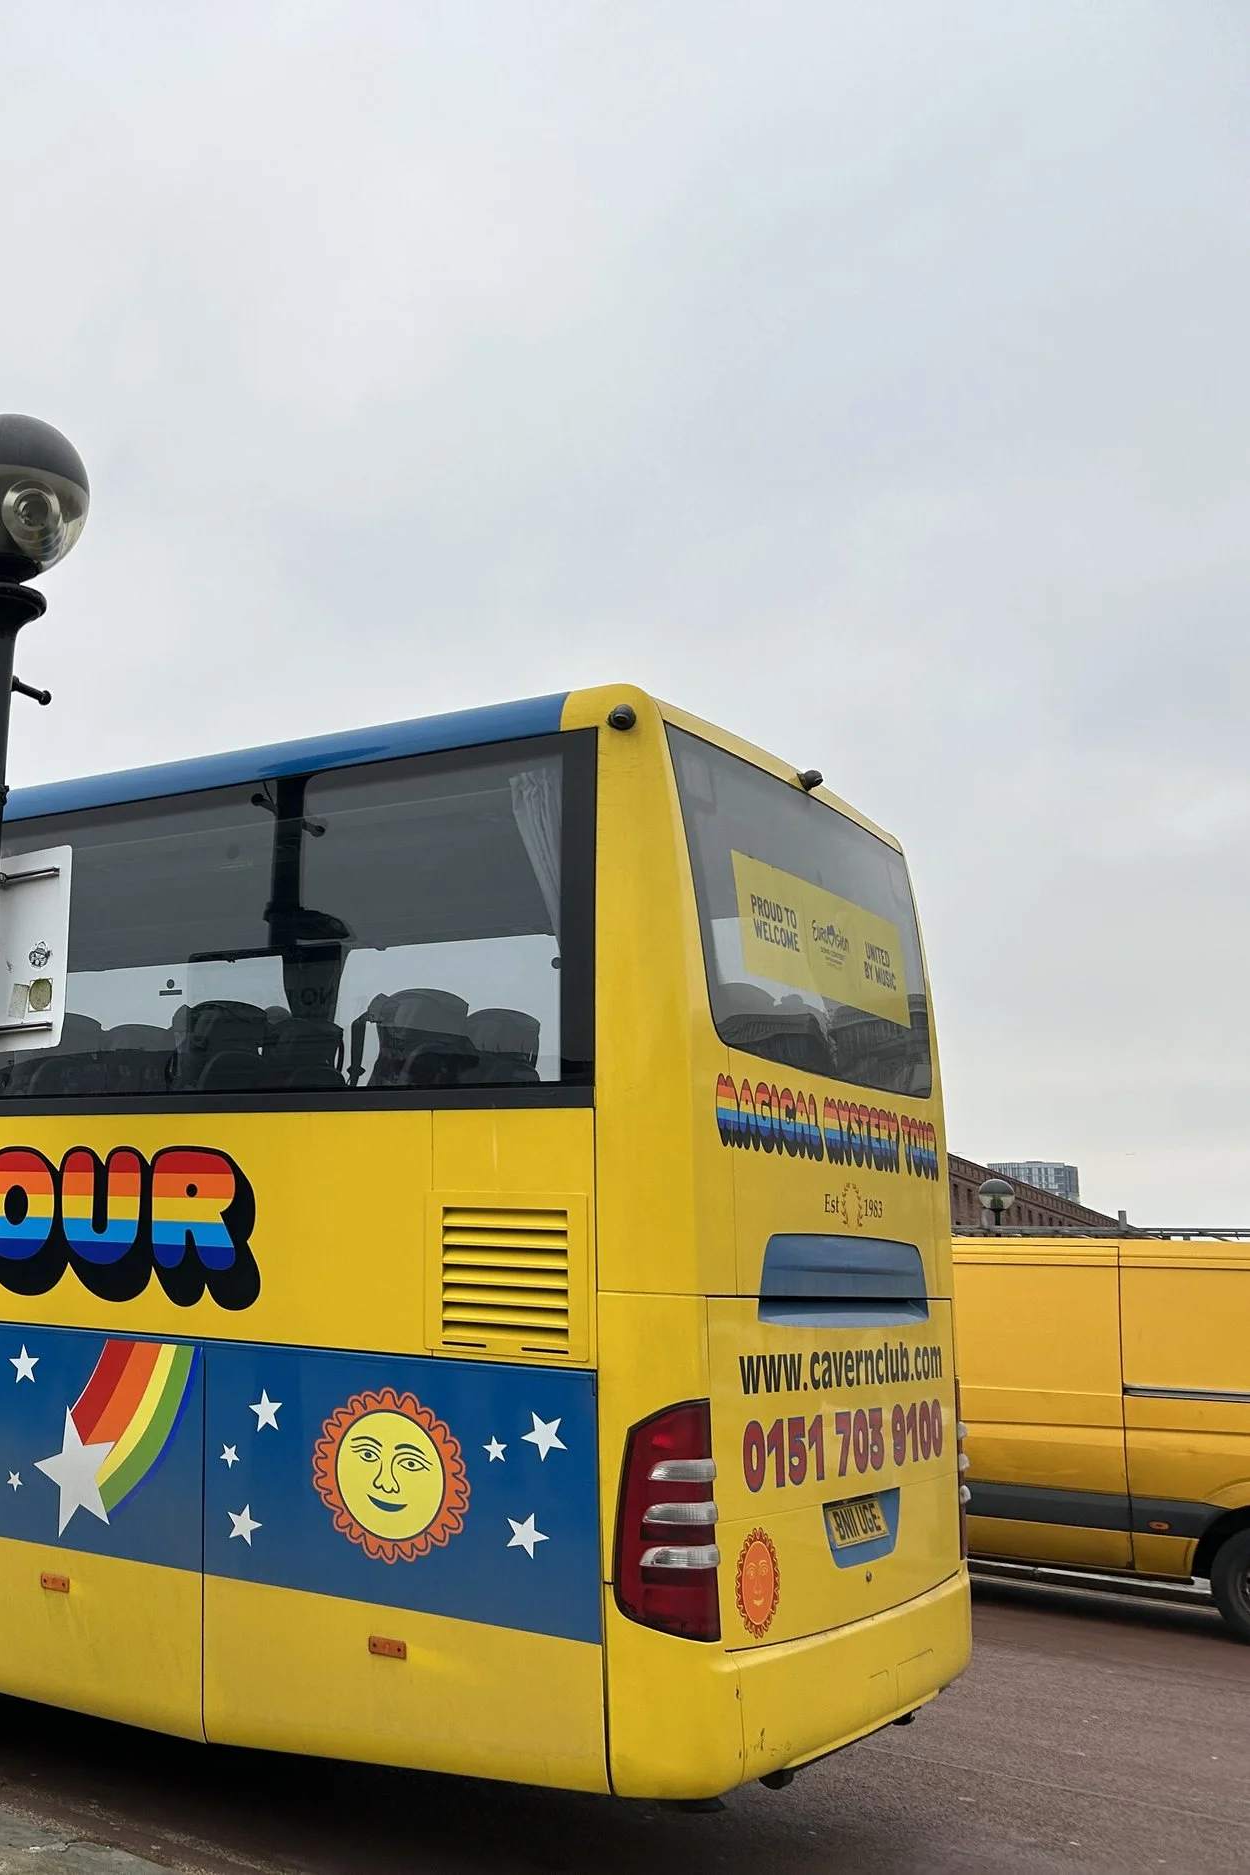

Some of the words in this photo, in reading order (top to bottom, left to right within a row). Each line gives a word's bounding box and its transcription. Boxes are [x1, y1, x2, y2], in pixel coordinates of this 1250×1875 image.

[750, 893, 782, 924] PROUD
[784, 907, 797, 930] TO
[753, 918, 800, 953] WELCOME
[864, 941, 891, 968] UNITED
[864, 961, 873, 980] BY
[874, 968, 897, 991] MUSIC
[716, 1072, 824, 1162] MAGICAL
[823, 1096, 900, 1174] MYSTERY
[901, 1114, 939, 1182] TOUR
[824, 1194, 840, 1214] Est
[864, 1199, 883, 1219] 1983
[739, 1342, 943, 1395] www.cavernclub.com
[743, 1413, 825, 1493] 0151
[835, 1407, 885, 1477] 703
[891, 1398, 943, 1467] 9100
[854, 1502, 882, 1535] UGE
